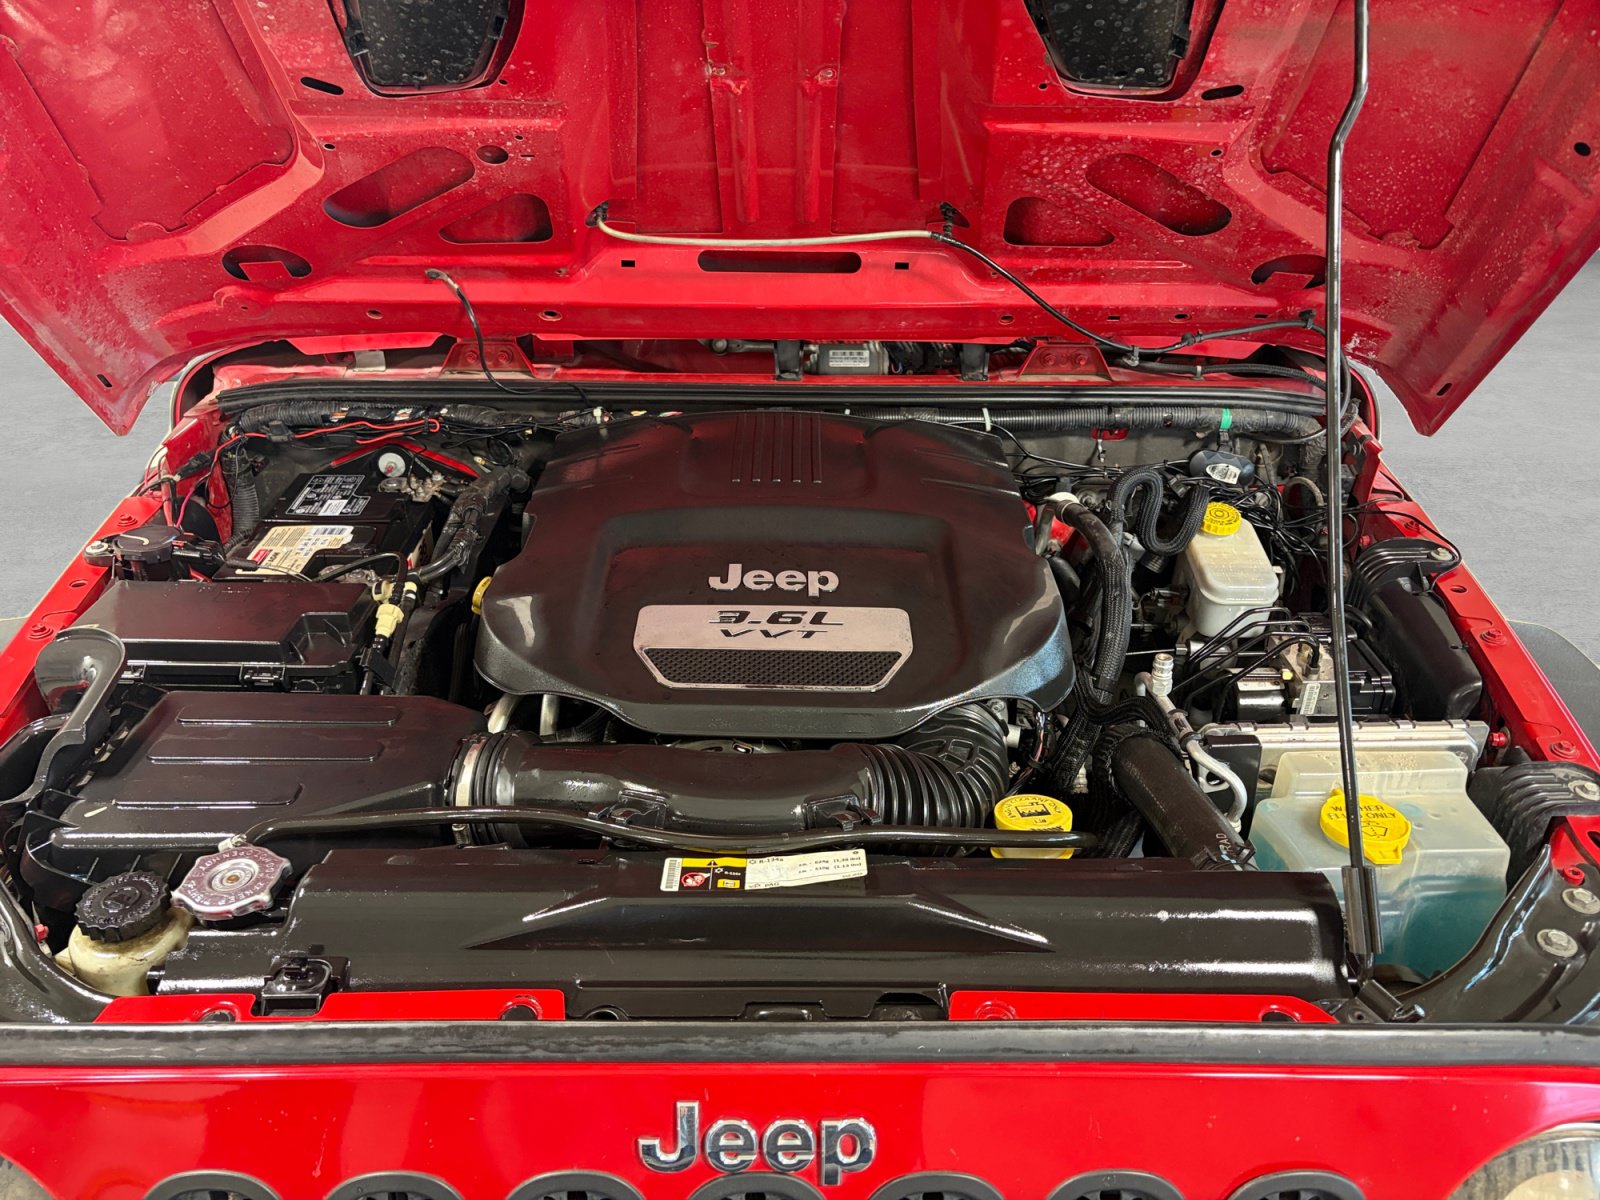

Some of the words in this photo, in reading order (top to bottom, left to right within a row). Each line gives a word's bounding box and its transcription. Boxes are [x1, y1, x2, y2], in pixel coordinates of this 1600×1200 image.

[708, 563, 840, 598] Jeep
[708, 610, 844, 626] 3.6L
[719, 628, 828, 639] VVT
[1331, 804, 1385, 812] WHER
[222, 850, 254, 859] OPEN
[758, 857, 784, 865] R-134a
[199, 856, 221, 871] HOT
[638, 1100, 877, 1187] Jeep
